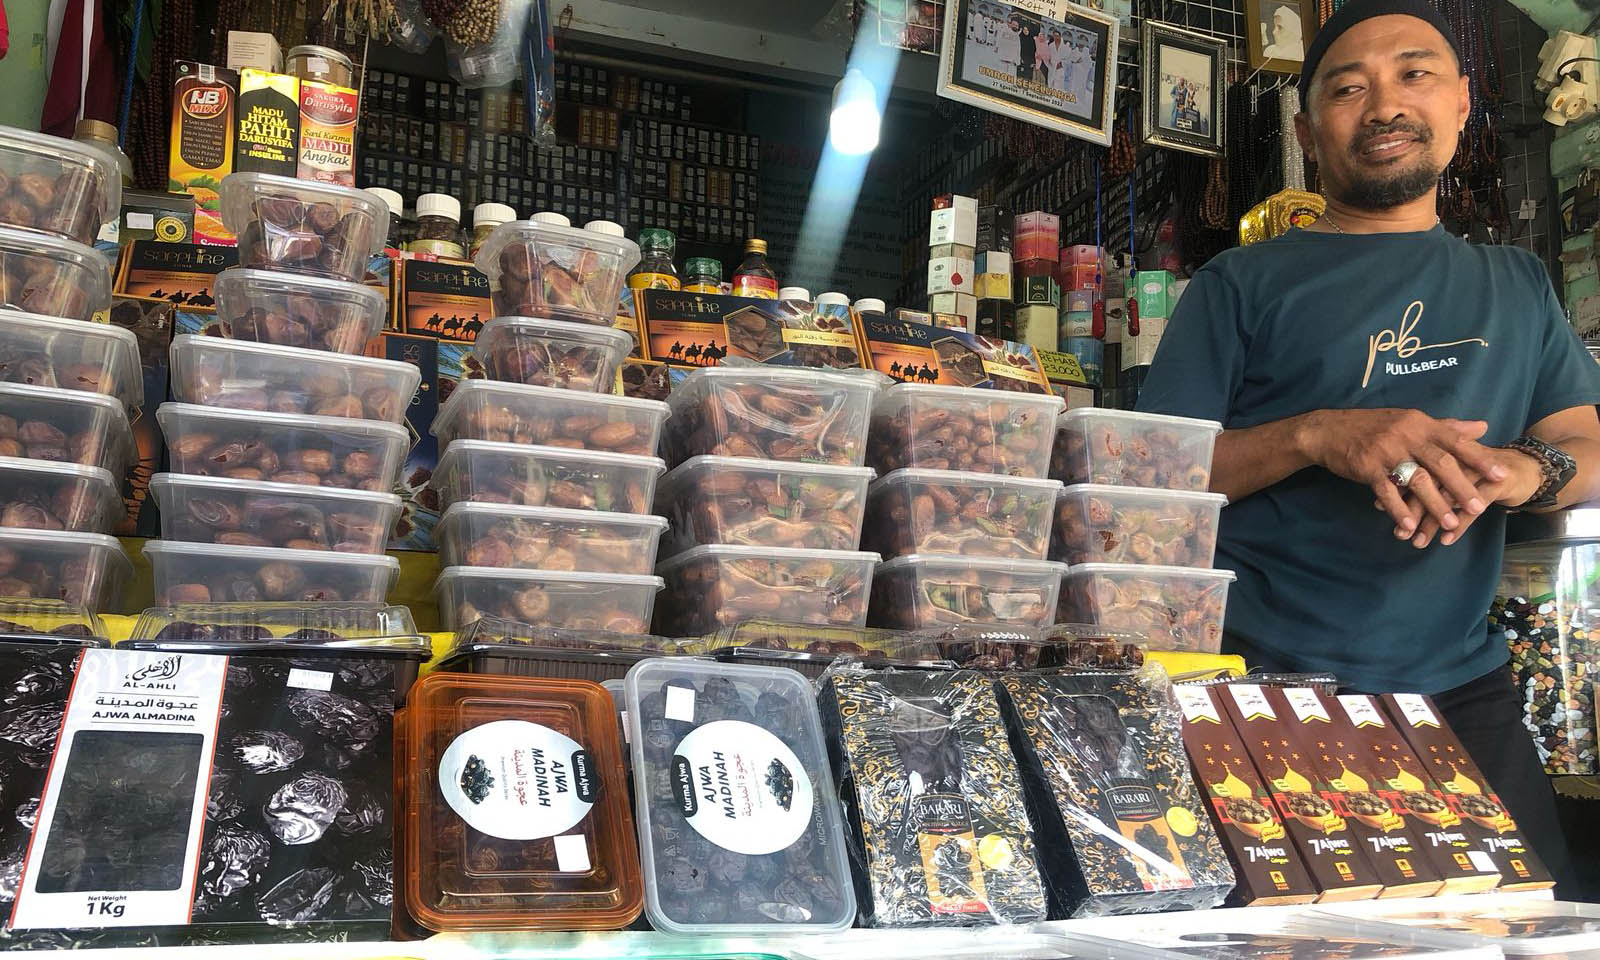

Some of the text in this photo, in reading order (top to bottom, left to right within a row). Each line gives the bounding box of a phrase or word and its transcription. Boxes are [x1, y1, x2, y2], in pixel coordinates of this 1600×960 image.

[978, 65, 1014, 84] UMROH
[190, 90, 220, 105] NB
[304, 97, 353, 113] Darusyifa
[252, 106, 284, 118] MADU
[247, 113, 289, 128] HITAM
[240, 120, 295, 140] PAHIT
[240, 133, 294, 149] DARUSYIFA
[305, 138, 349, 154] MADU
[248, 150, 286, 162] INSULINE
[302, 149, 349, 166] Angkak
[1386, 357, 1458, 375] PULL&BEAR
[123, 681, 177, 690] AL-AHLI
[95, 696, 198, 710] عجوة المدينة
[92, 711, 195, 722] AJWA ALMADINA
[531, 748, 551, 807] MADINAH
[550, 760, 568, 793] AJWA
[576, 754, 590, 796] Kurma Ajwa
[678, 763, 693, 811] Kurma Ajwa
[698, 765, 717, 804] AJWA
[713, 751, 736, 819] MADINAH
[1112, 793, 1151, 804] BARARI
[87, 902, 125, 918] 1 Kg
